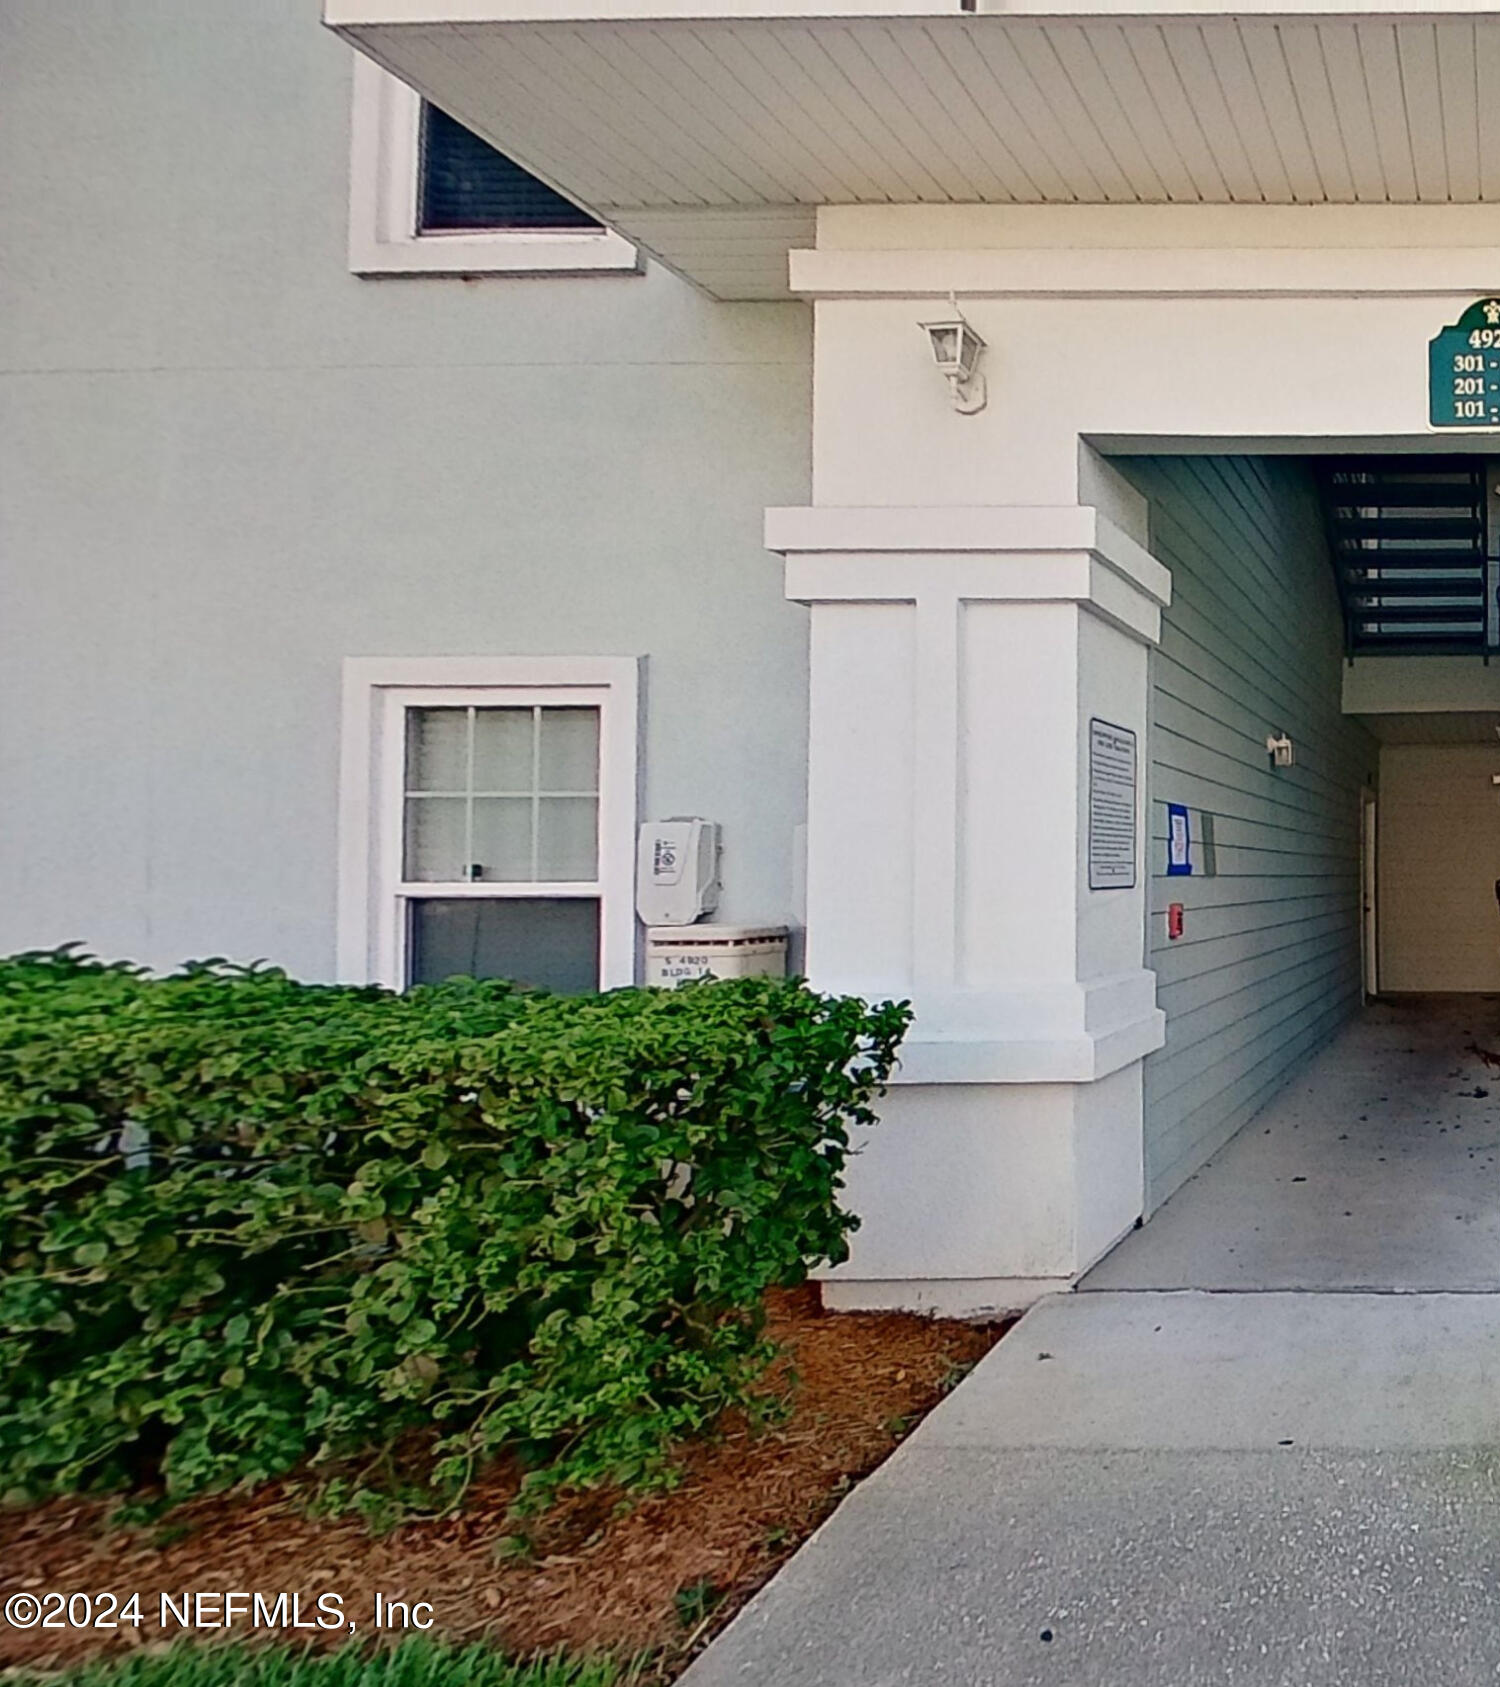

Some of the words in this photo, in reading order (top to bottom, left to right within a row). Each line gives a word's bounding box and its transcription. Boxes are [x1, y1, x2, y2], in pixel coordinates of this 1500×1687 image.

[1453, 355, 1485, 372] 301
[1454, 378, 1485, 394] 201
[1454, 401, 1485, 418] 101
[661, 967, 692, 977] BLDG
